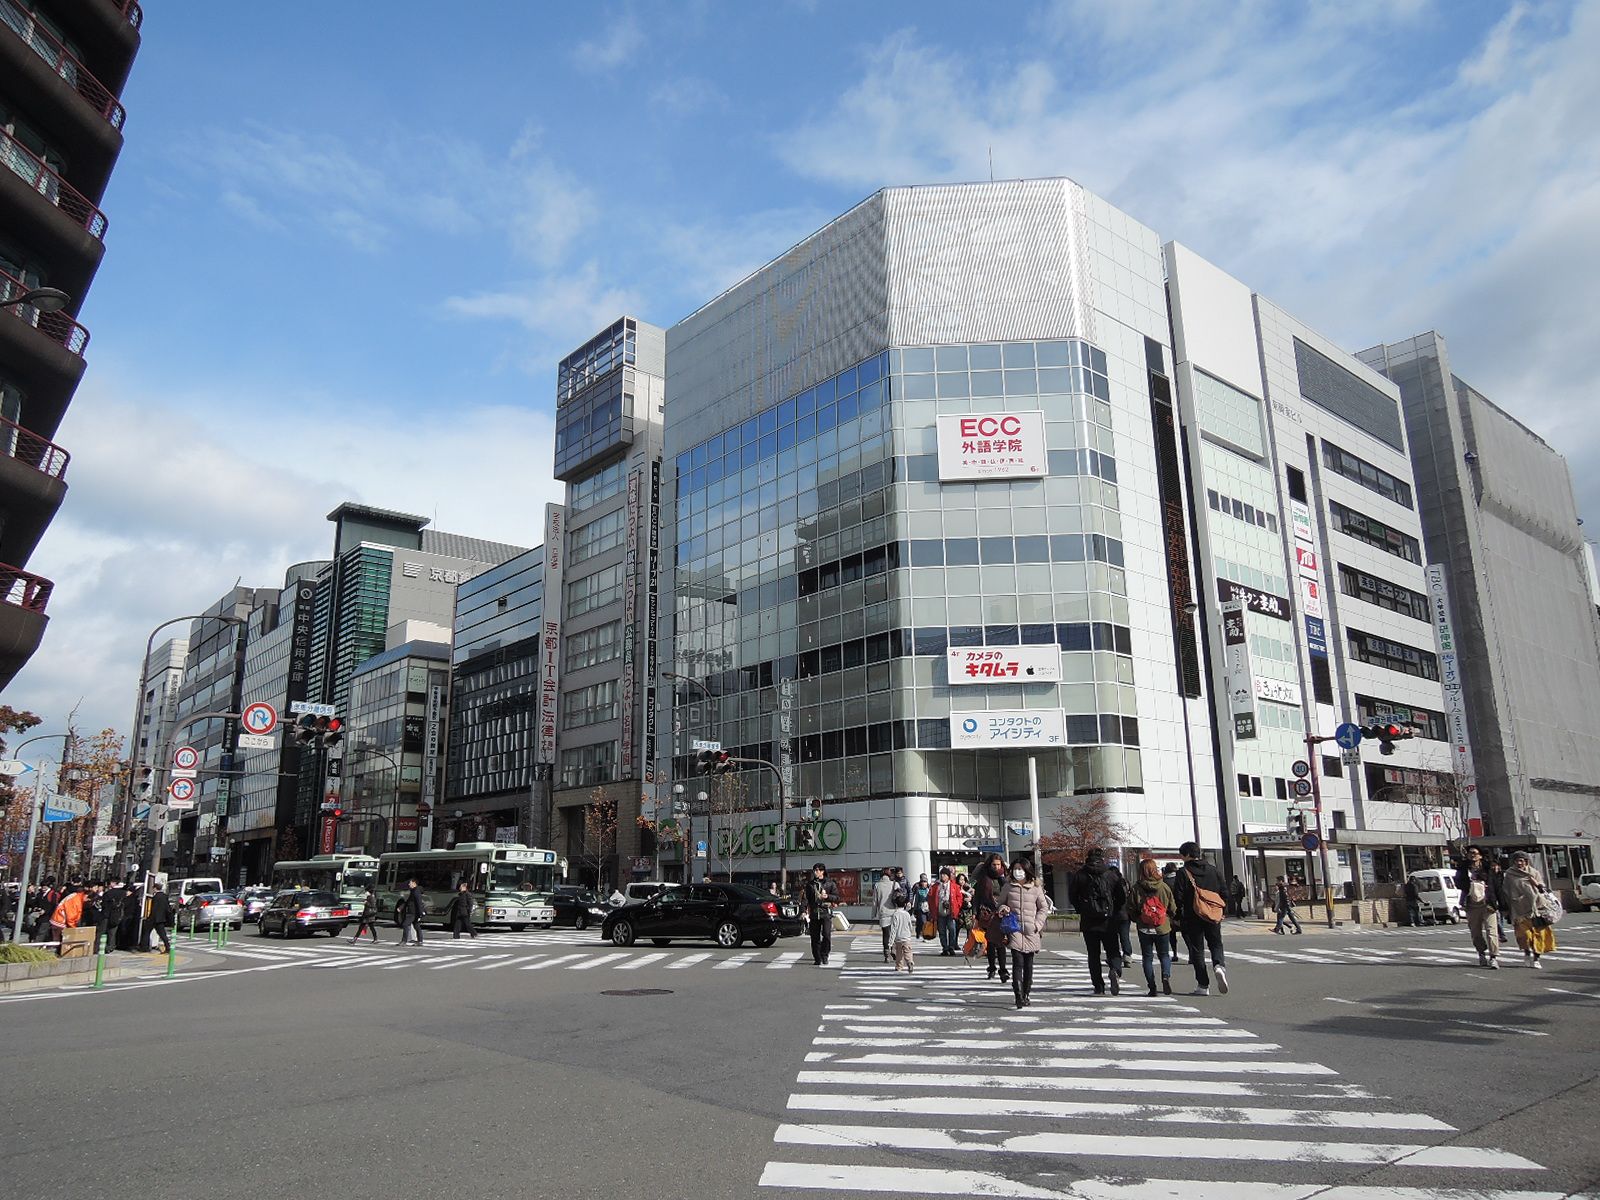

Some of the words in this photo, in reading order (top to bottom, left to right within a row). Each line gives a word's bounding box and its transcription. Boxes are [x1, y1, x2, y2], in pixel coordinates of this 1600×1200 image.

[960, 416, 1021, 437] ECC
[962, 439, 1023, 454] 外語学院
[1430, 570, 1443, 592] TBC
[291, 613, 310, 683] 中央信用金庫
[965, 652, 1003, 661] カメラの
[965, 662, 1019, 677] キタムラ
[989, 716, 1041, 727] コンタクトの
[244, 736, 269, 746] ここから
[989, 727, 1041, 740] アイシティ
[1048, 735, 1060, 743] 3F
[179, 753, 193, 764] 40
[717, 818, 846, 856] PACHIKO
[947, 823, 991, 839] LUCKY
